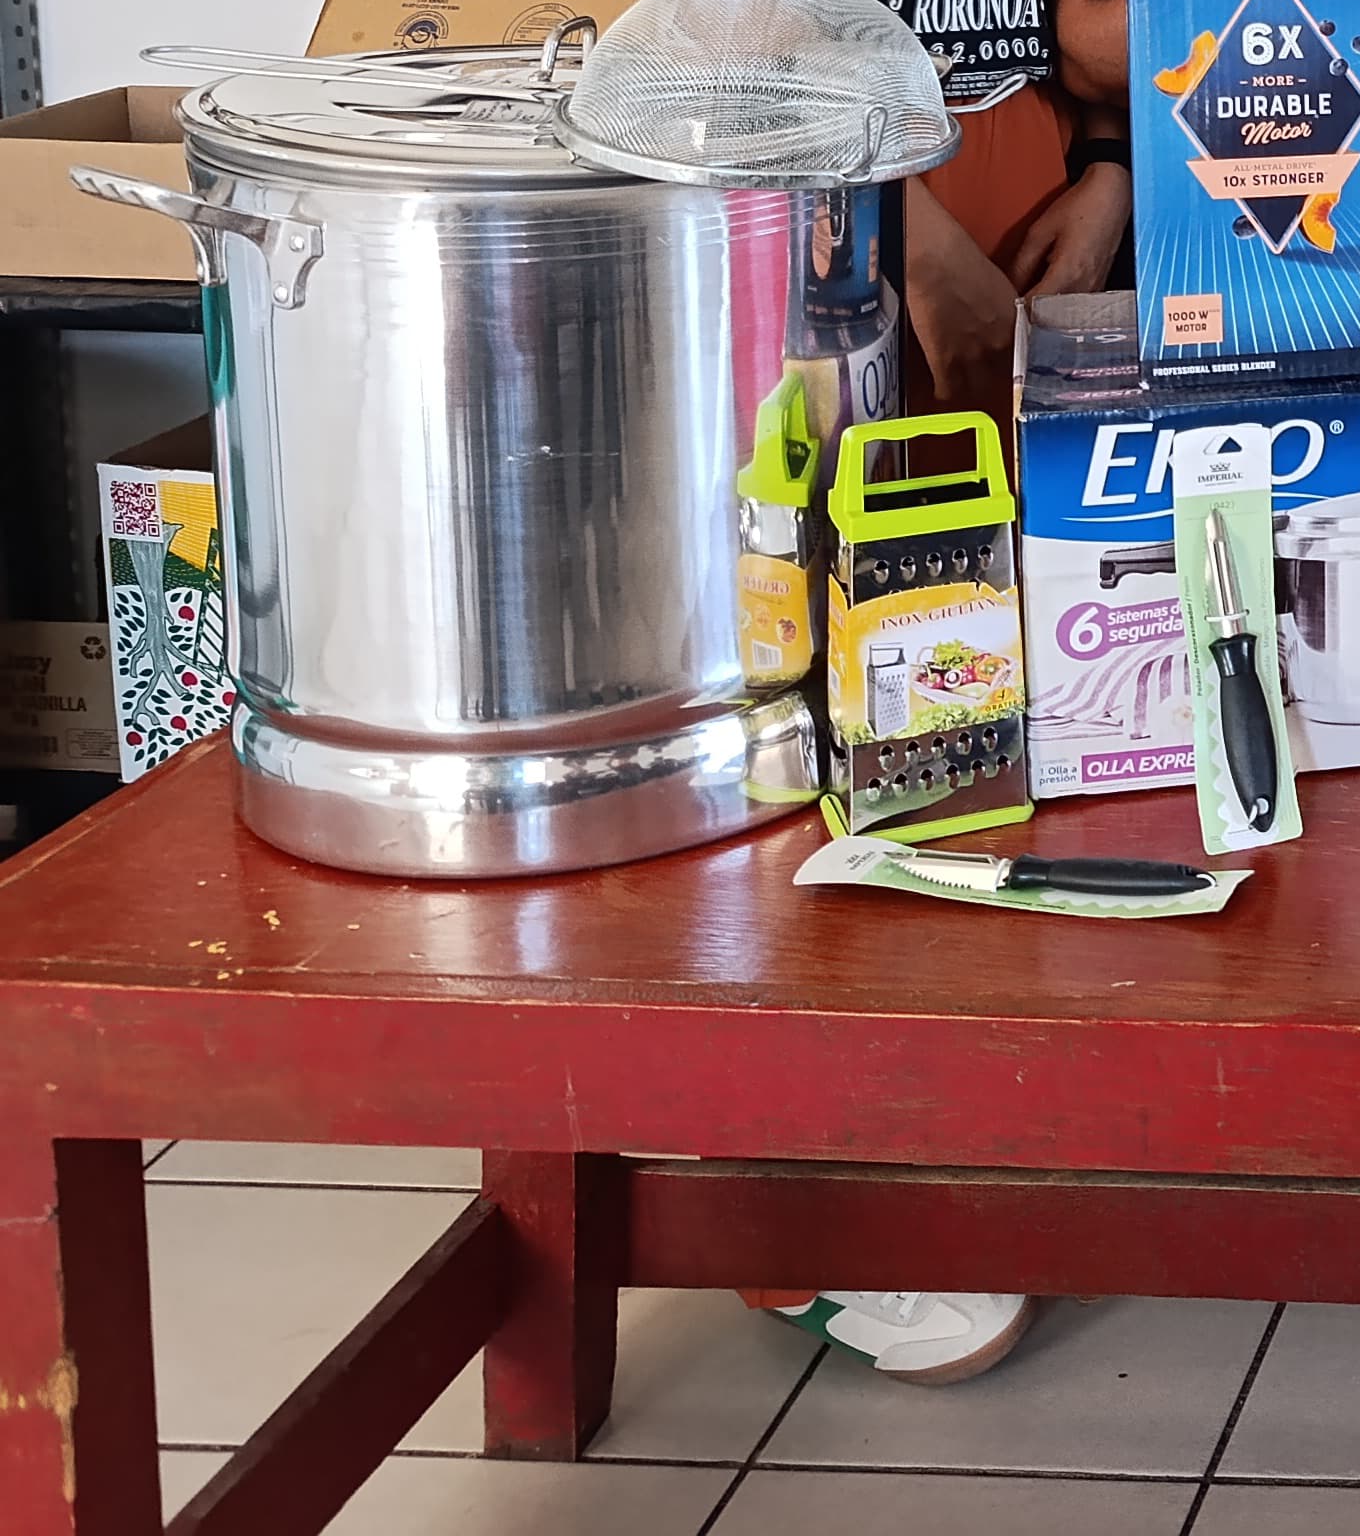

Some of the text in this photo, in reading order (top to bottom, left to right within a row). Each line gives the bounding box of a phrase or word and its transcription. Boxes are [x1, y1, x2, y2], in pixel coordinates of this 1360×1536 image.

[1241, 22, 1305, 66] 6X
[1252, 75, 1294, 88] MORE
[1217, 93, 1332, 119] DURABLE
[1241, 121, 1313, 146] Motor
[1223, 172, 1325, 188] 10x STRONGER
[1168, 311, 1196, 323] 1000
[1175, 323, 1207, 333] MOTOR
[1153, 365, 1210, 377] PROFESSIONAL
[1212, 363, 1239, 373] SERIES
[1241, 360, 1276, 372] BLENDER
[1081, 419, 1326, 507] EO
[1197, 471, 1244, 483] IMPERIAL
[1107, 600, 1183, 626] Sistemas d
[1069, 606, 1103, 653] 6
[1108, 615, 1183, 643] segurida
[1047, 766, 1068, 775] Olla
[1086, 752, 1195, 777] OLLA EXPRE
[1039, 774, 1077, 786] presión
